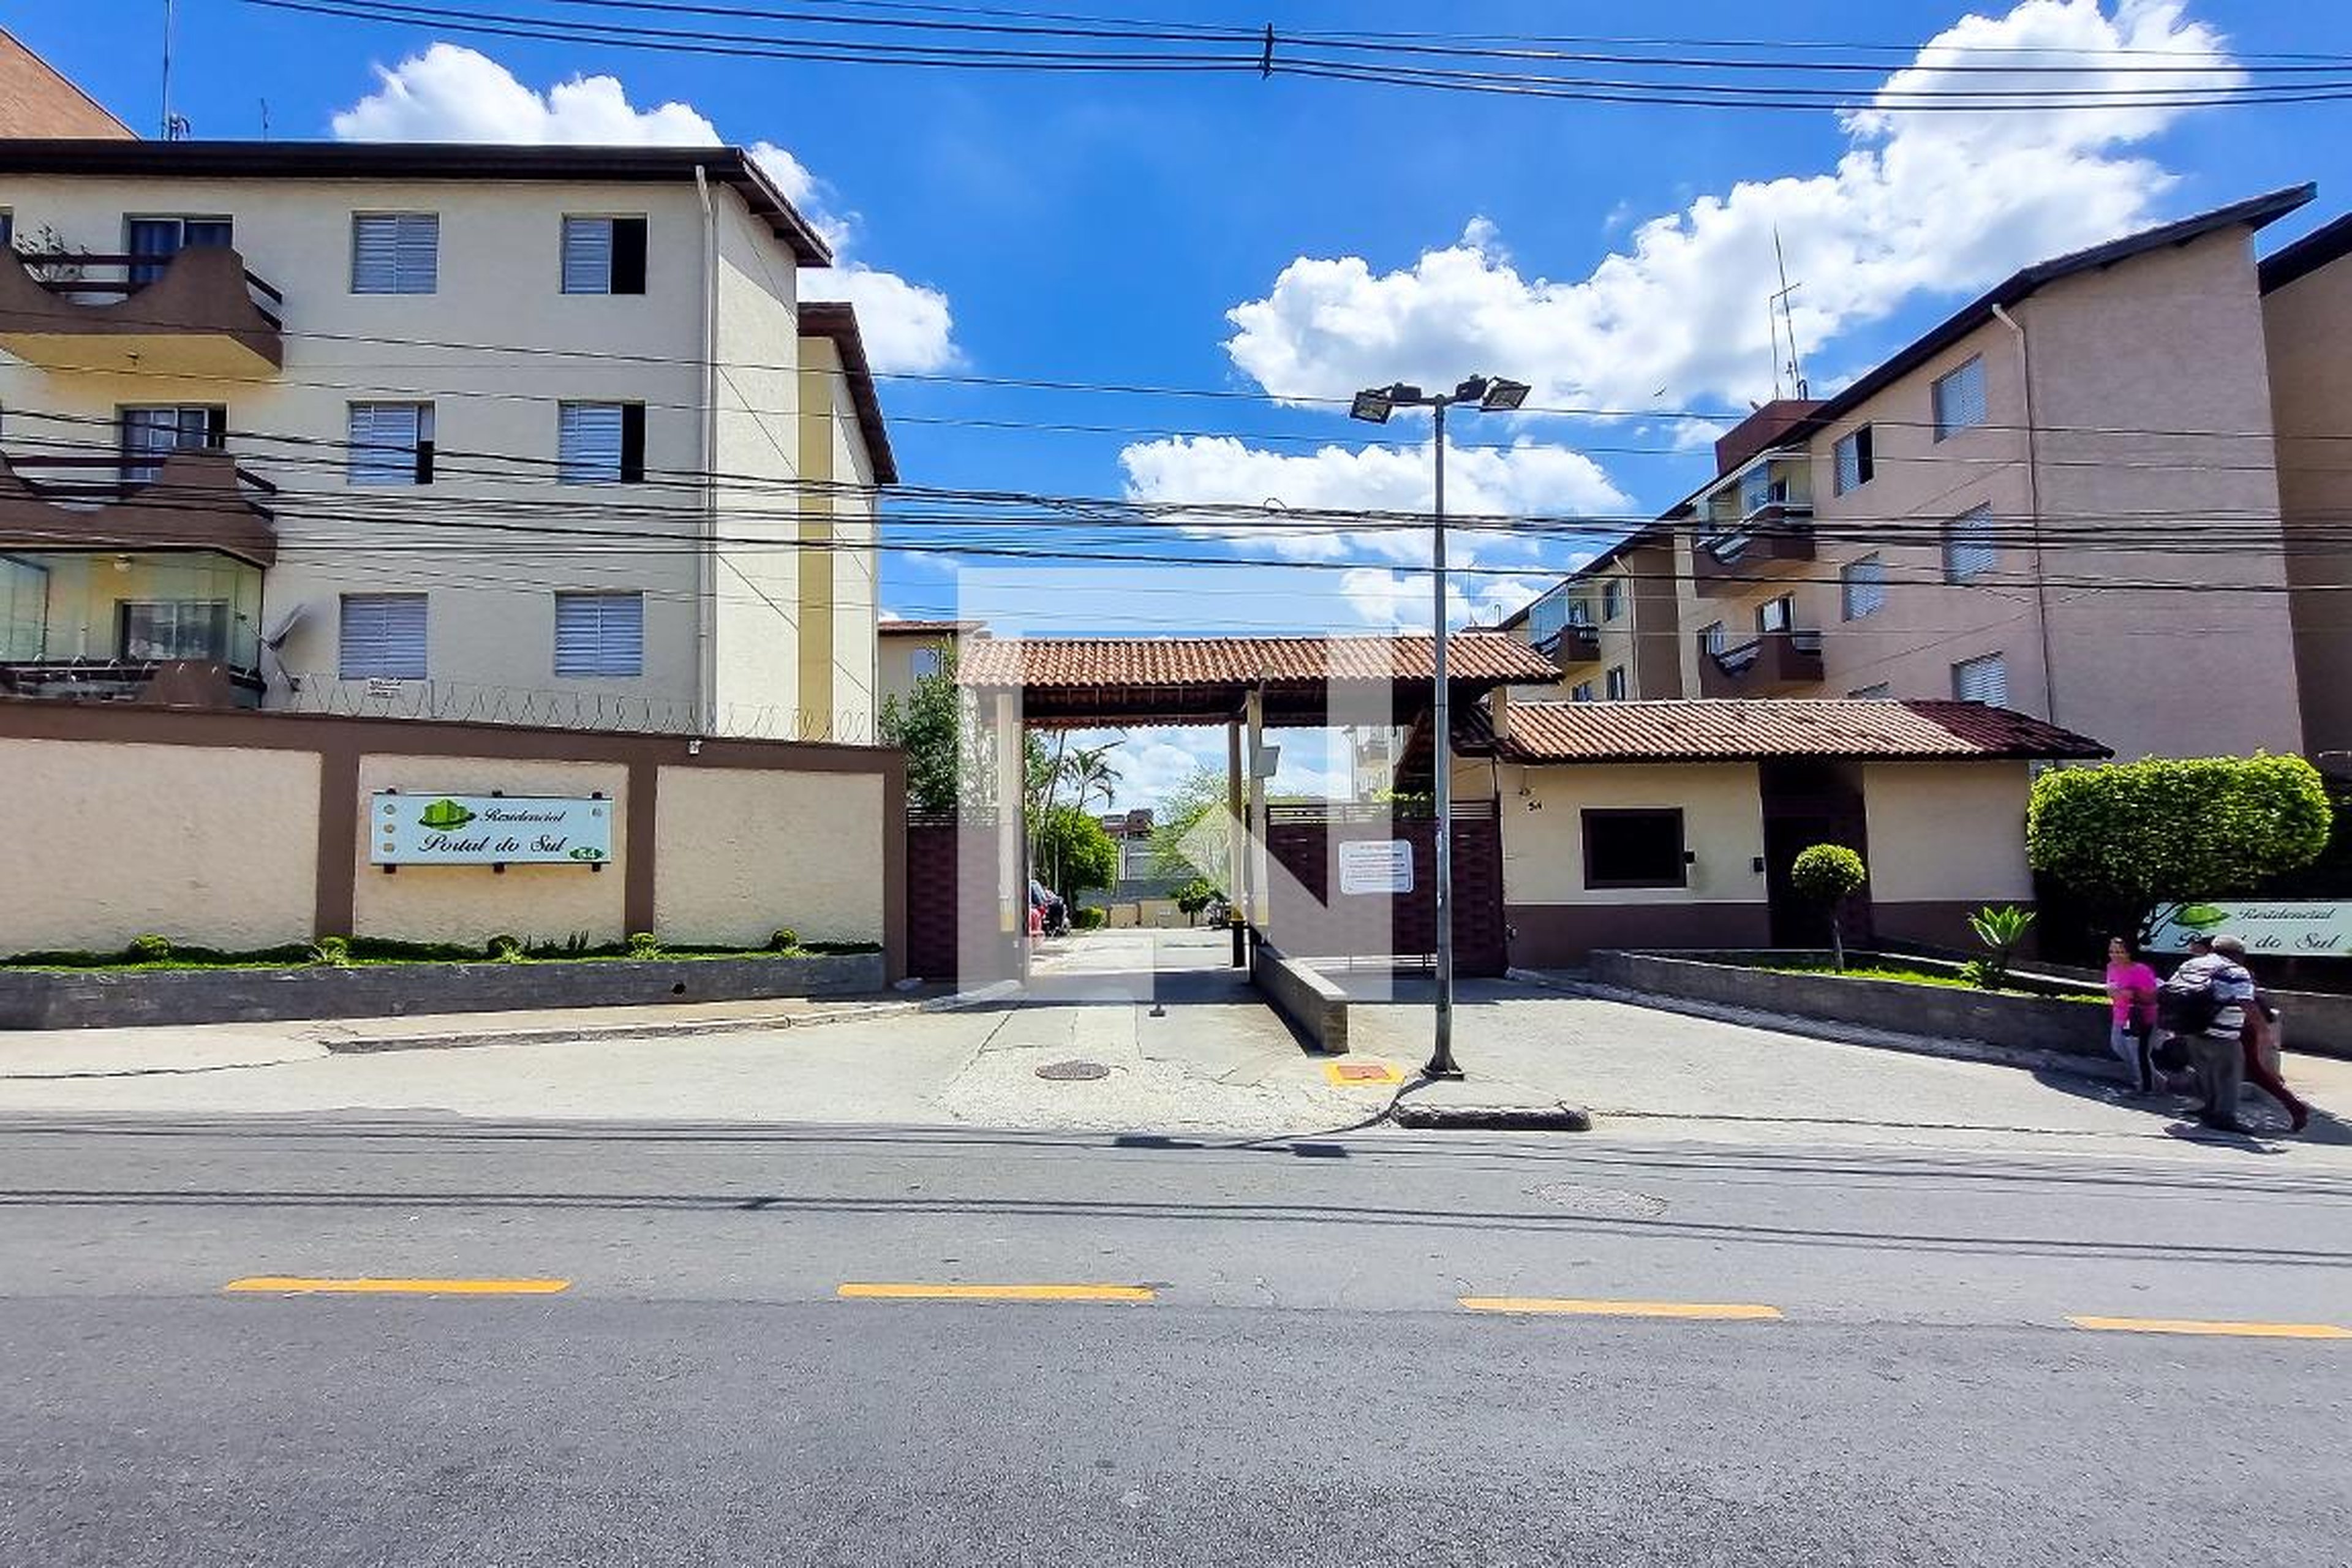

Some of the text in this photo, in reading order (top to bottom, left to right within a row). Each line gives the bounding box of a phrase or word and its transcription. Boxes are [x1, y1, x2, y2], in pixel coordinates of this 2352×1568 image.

[480, 808, 565, 823] Residencial
[418, 834, 568, 853] Portal do Sul
[2238, 907, 2336, 920] Residencial
[2255, 934, 2281, 949] do
[2294, 932, 2341, 950] Sul
